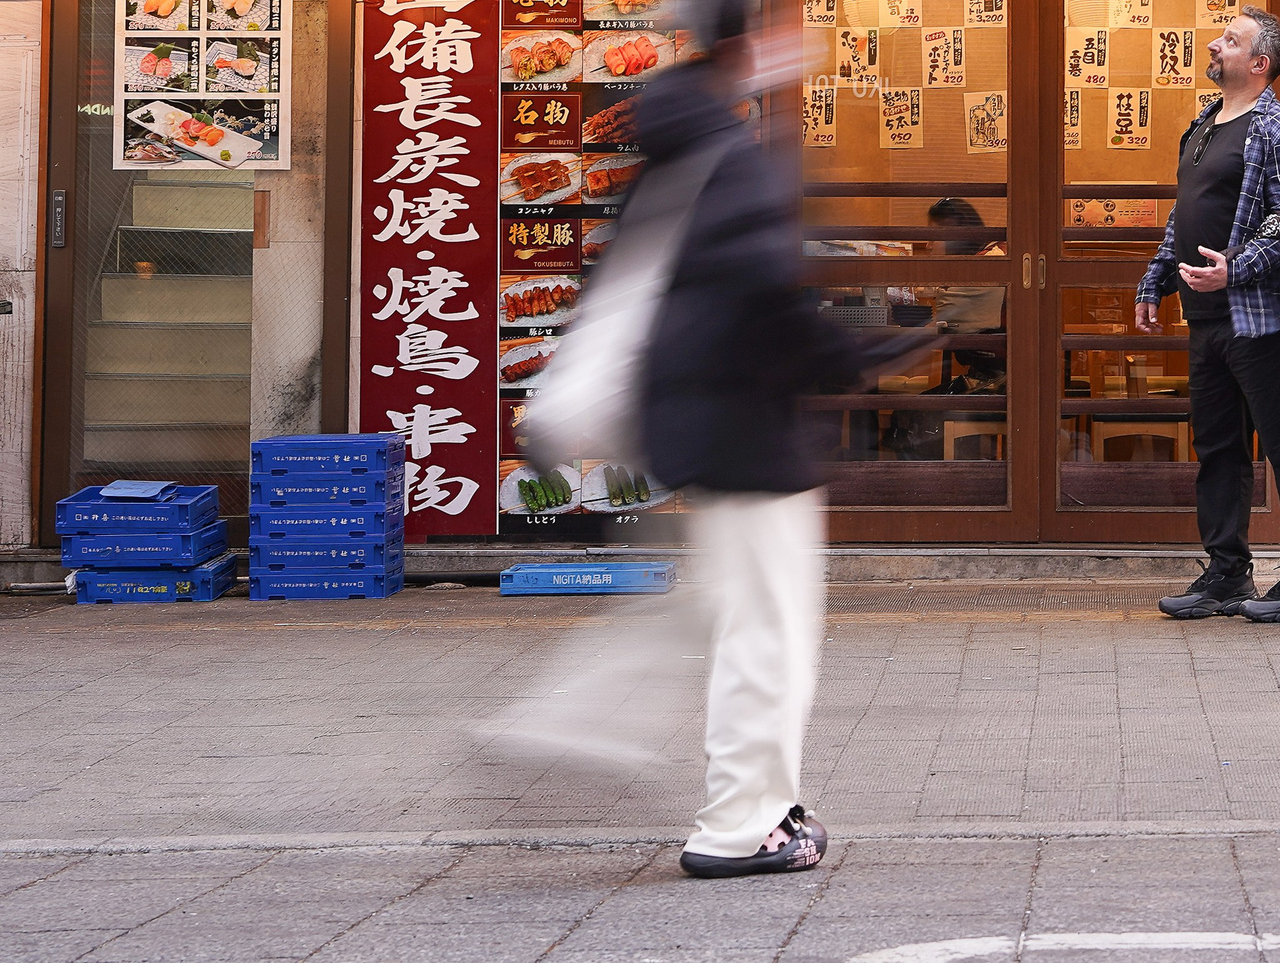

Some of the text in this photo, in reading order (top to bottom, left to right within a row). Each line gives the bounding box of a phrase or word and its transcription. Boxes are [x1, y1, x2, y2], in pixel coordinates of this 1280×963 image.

[975, 14, 1004, 23] 3,200
[1159, 31, 1181, 75] 冷奴
[1086, 75, 1106, 84] 480
[1172, 76, 1192, 84] 320
[512, 98, 570, 125] 名物
[890, 133, 912, 141] 950
[1127, 136, 1148, 145] 320
[517, 207, 554, 215] コンニャク
[508, 222, 575, 246] 特製豚
[528, 328, 553, 336] 豚シロ
[526, 516, 557, 524] ししとう
[615, 516, 639, 524] オクラ
[552, 574, 612, 585] NIGITA納品用
